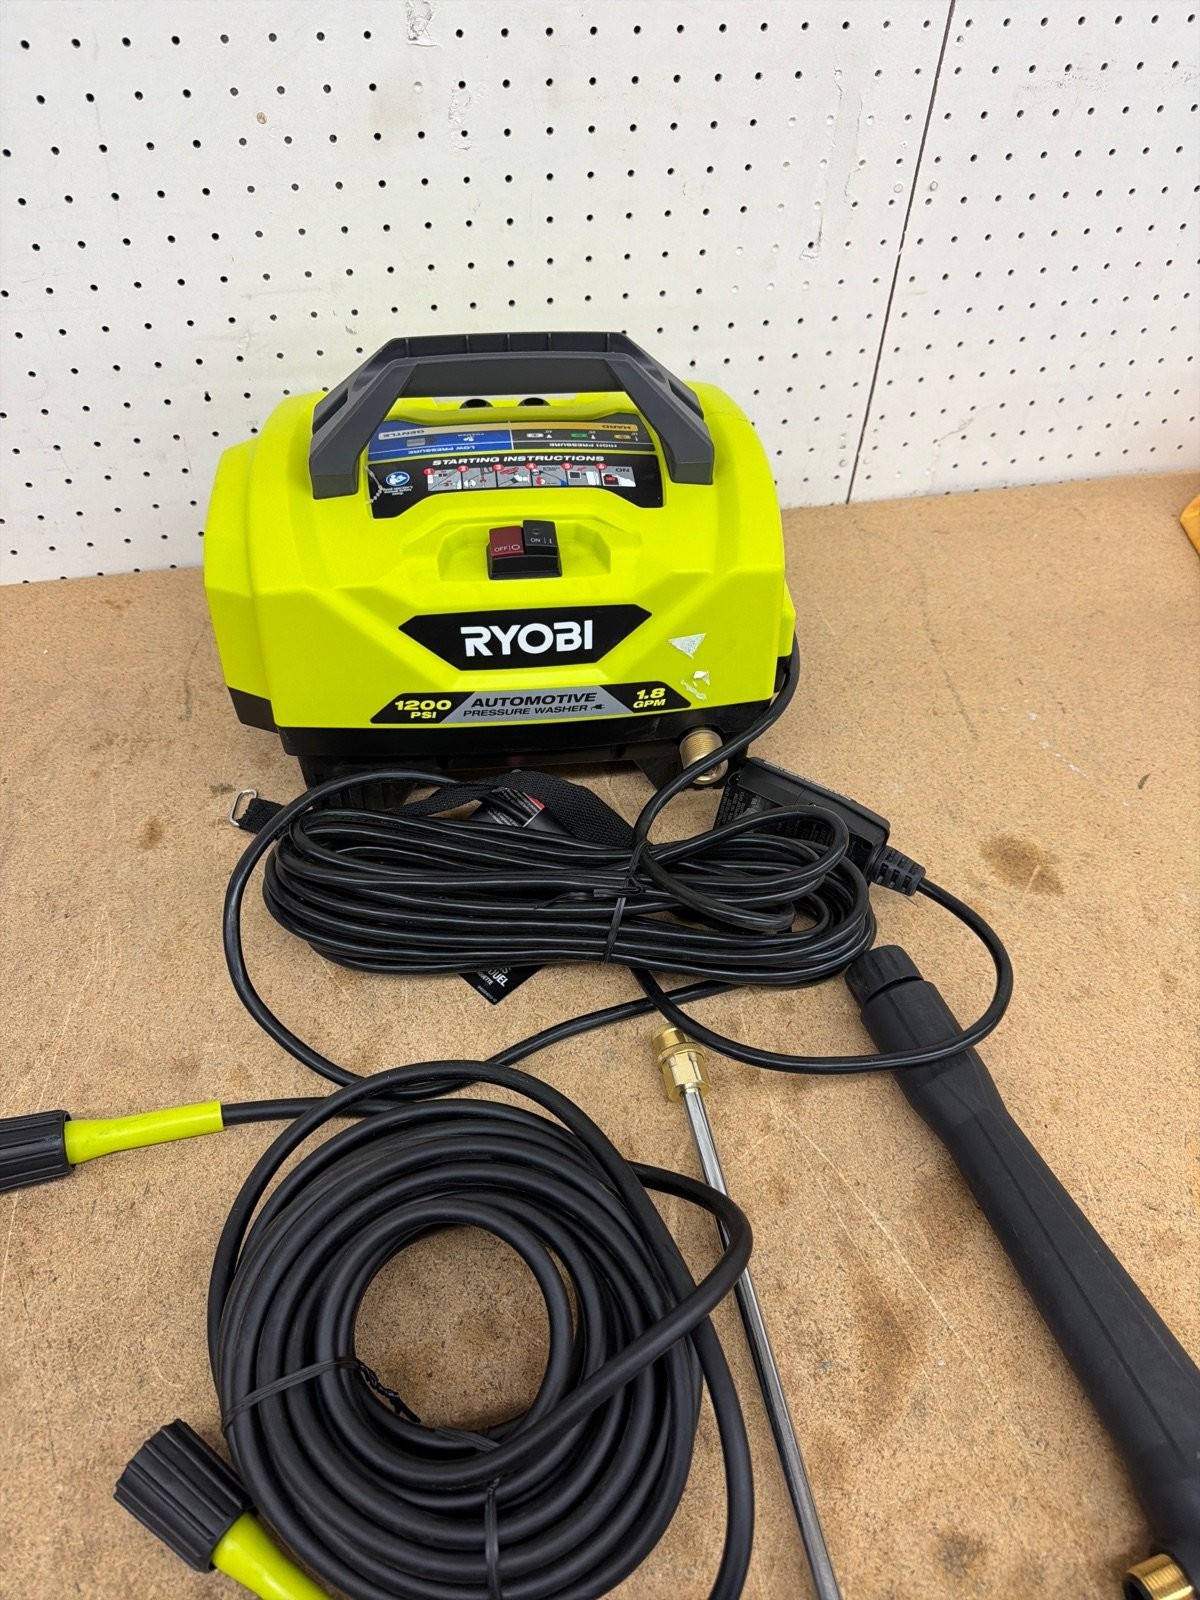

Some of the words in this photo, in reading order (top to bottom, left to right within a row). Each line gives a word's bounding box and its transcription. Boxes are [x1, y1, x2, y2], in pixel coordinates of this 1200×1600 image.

[382, 429, 425, 438] GENTLE
[407, 446, 454, 454] PRESSURE
[432, 456, 500, 465] STARTING
[460, 619, 593, 657] RYOBI
[636, 687, 666, 700] 1.8
[394, 699, 452, 711] 1200
[471, 692, 598, 708] AUTOMOTIVE
[632, 698, 666, 708] GPM
[410, 711, 437, 719] PSI
[463, 707, 531, 717] PRESSURE
[534, 704, 588, 714] WASHER
